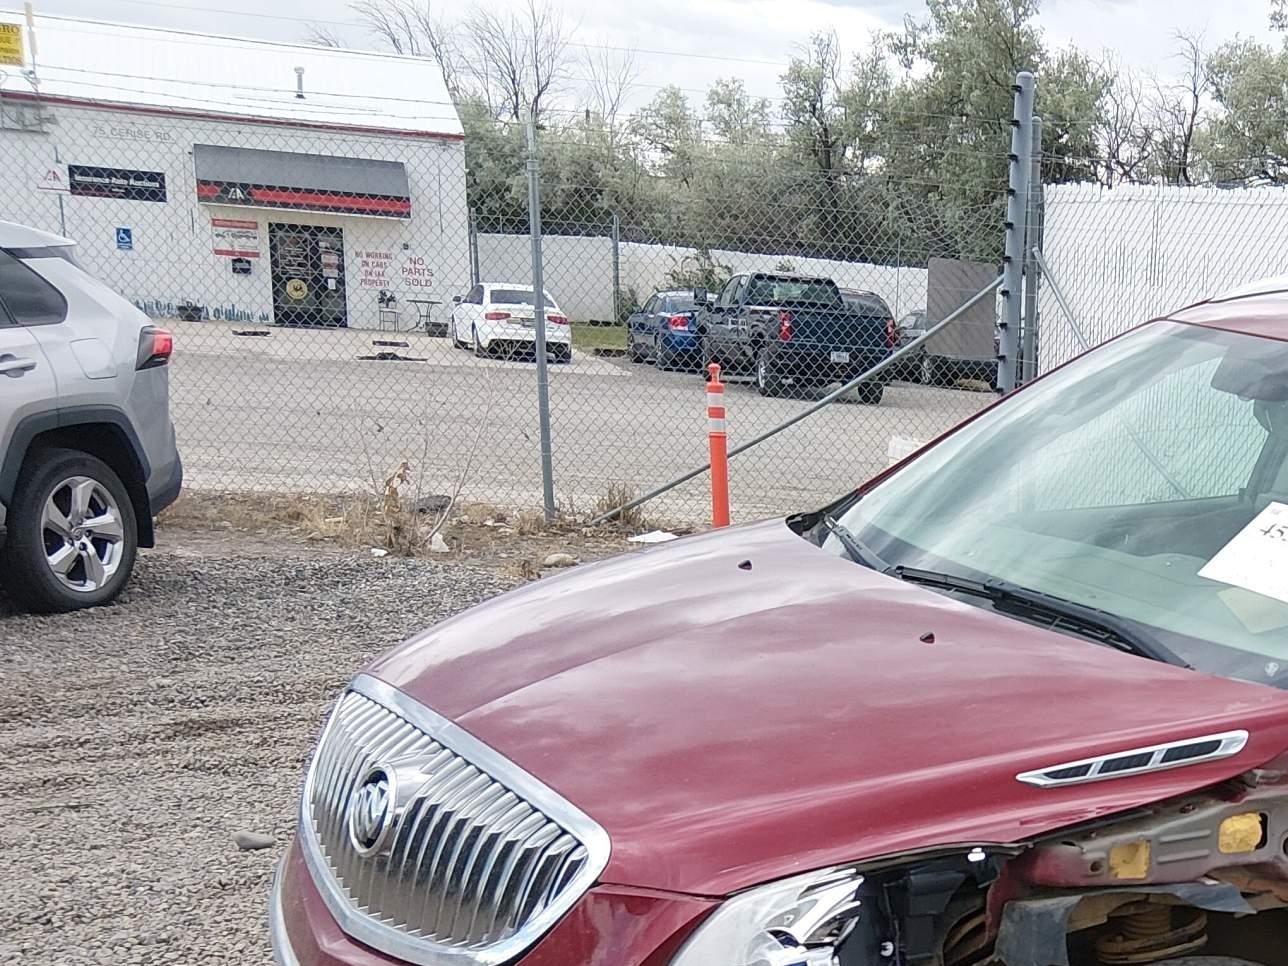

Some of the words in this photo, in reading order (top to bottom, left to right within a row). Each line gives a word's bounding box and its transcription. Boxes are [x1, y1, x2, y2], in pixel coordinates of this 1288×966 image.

[110, 127, 152, 140] CERISE
[129, 178, 160, 188] Auctions
[354, 250, 363, 258] NO
[365, 251, 393, 260] WORKING
[361, 260, 369, 268] ON
[409, 257, 424, 266] NO
[401, 267, 434, 277] PARTS
[360, 278, 390, 287] PROPERTY
[405, 278, 432, 287] SOLD
